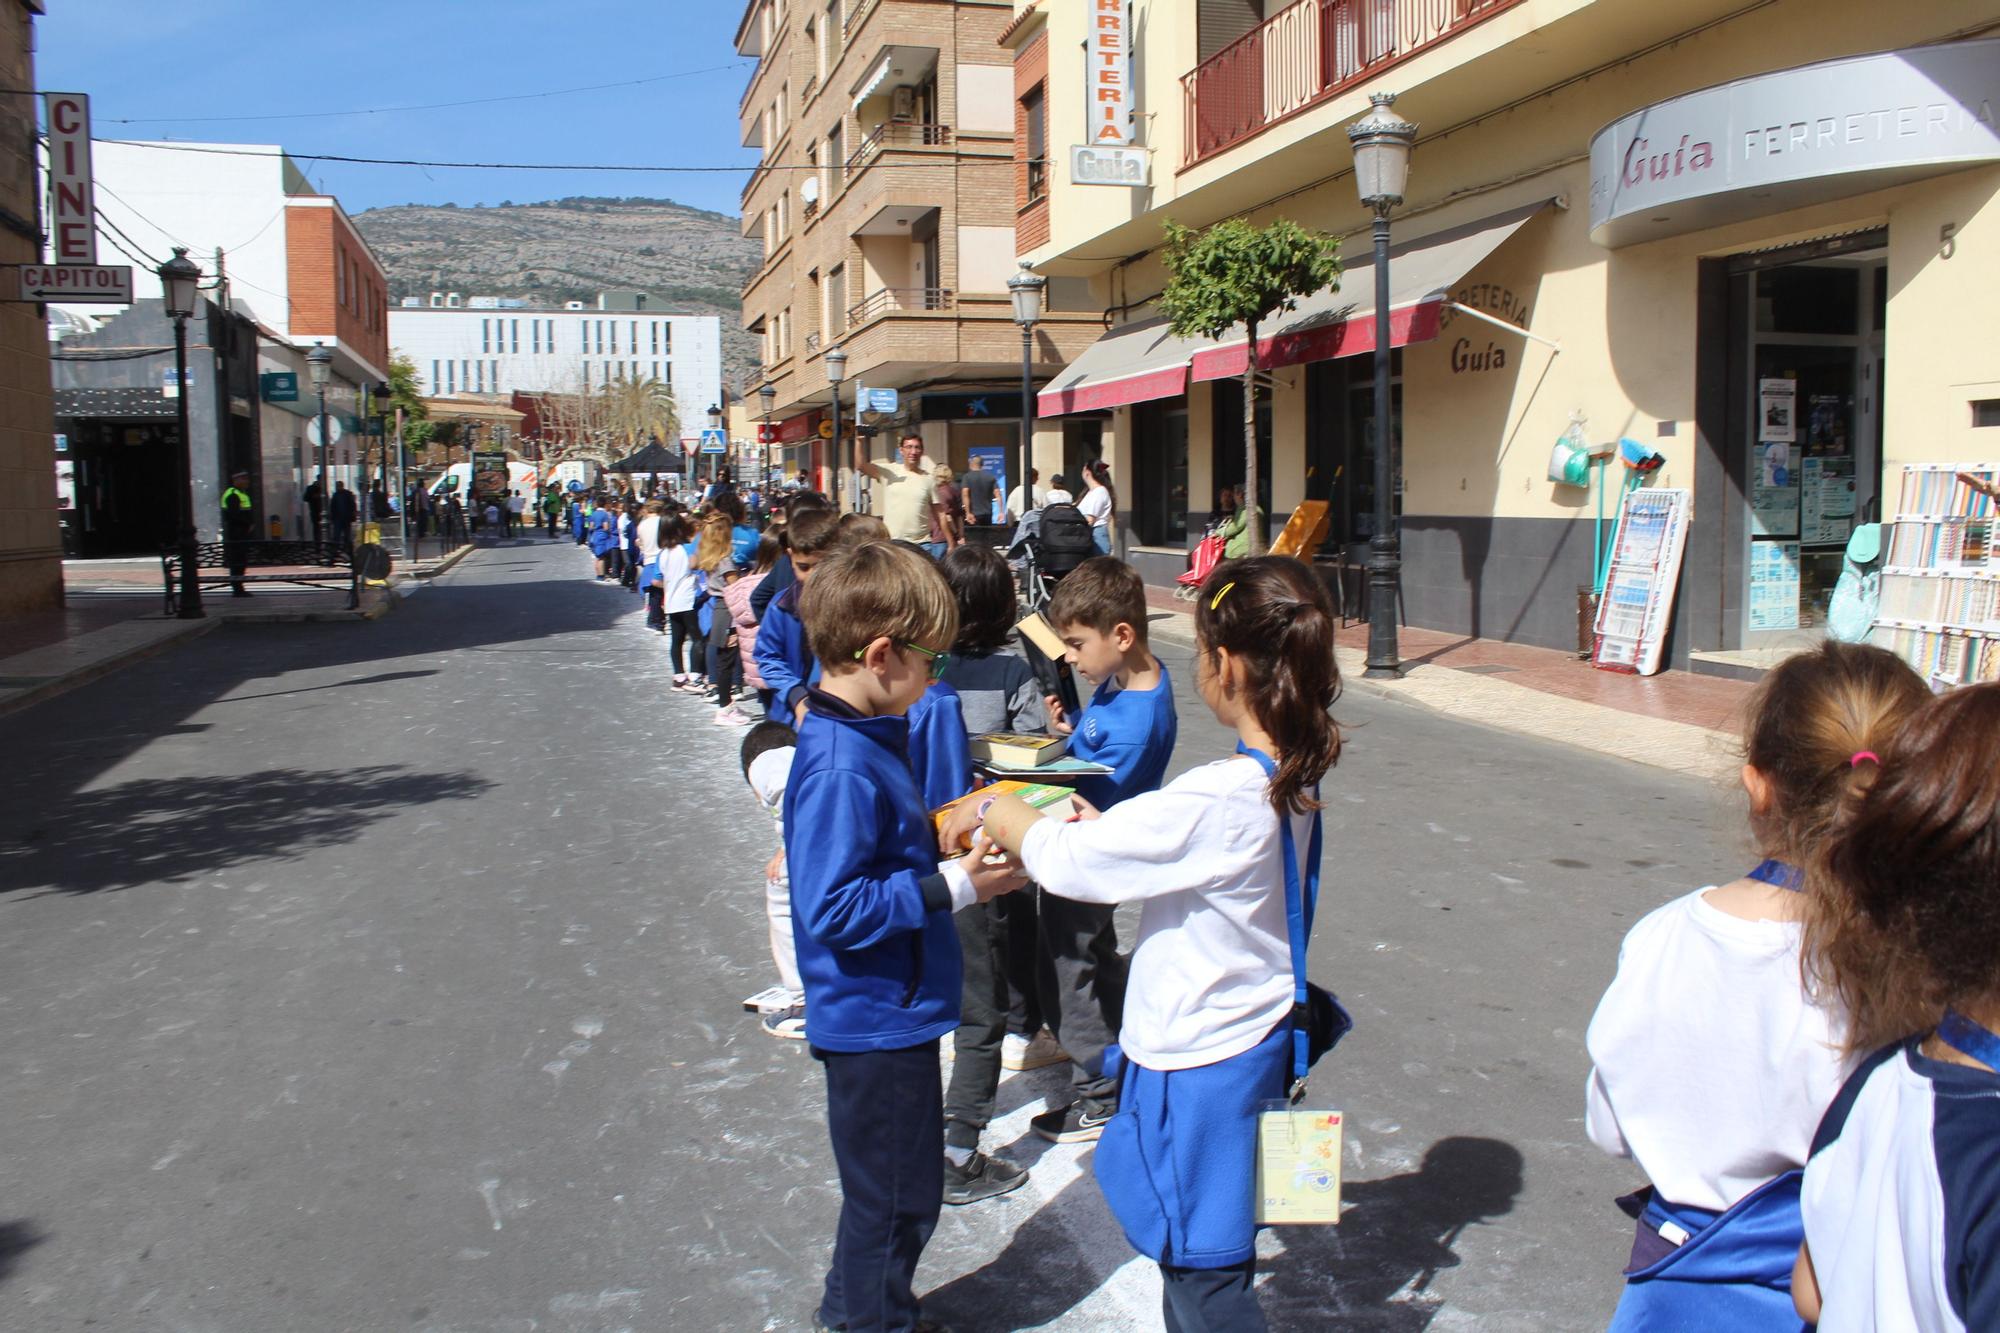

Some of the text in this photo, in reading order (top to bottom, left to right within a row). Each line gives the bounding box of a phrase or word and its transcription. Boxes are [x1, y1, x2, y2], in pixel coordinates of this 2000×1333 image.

[54, 100, 88, 257] CINE
[1077, 149, 1141, 181] Guía
[1622, 134, 1714, 189] Guía
[1939, 222, 1956, 260] 5
[25, 268, 125, 287] CAPITOL
[1451, 337, 1506, 374] Guía
